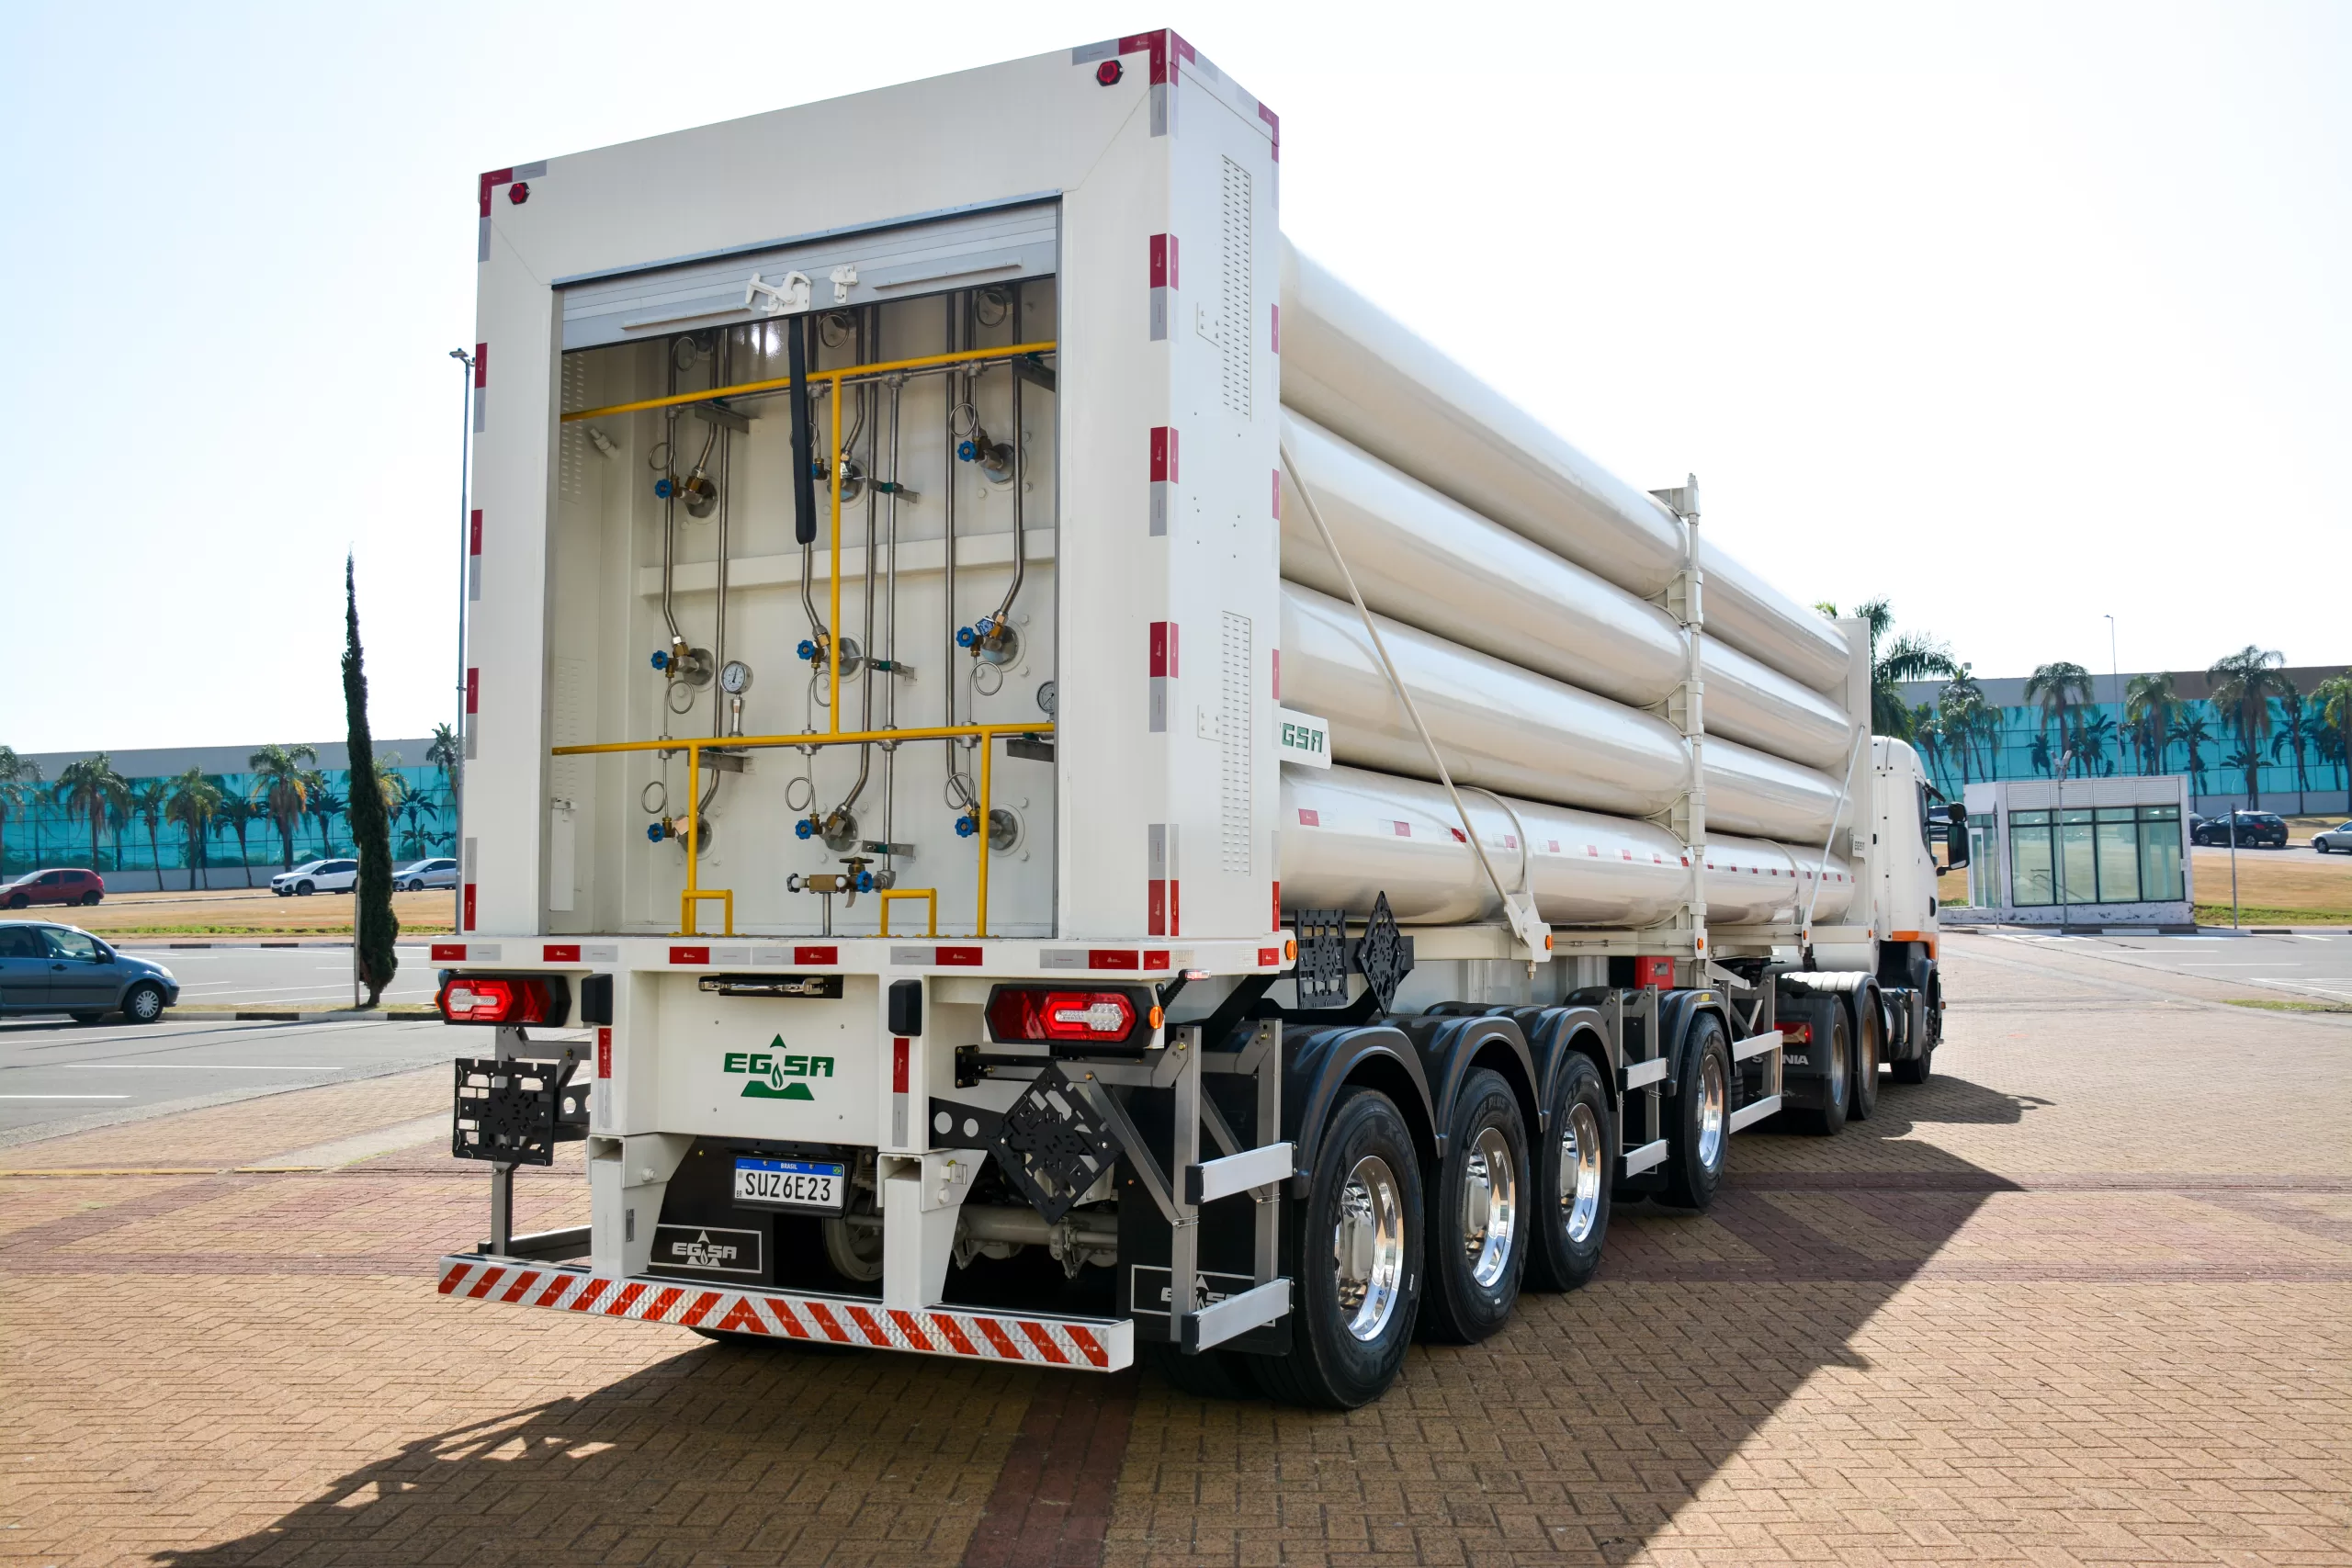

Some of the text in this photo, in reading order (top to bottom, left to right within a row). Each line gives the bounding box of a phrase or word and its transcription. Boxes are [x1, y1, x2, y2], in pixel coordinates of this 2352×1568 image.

[1280, 722, 1323, 753] GSA
[724, 1052, 834, 1077] EGSA
[1751, 1055, 1809, 1066] SNIA
[780, 1162, 797, 1170] BRASIL
[745, 1172, 831, 1201] SUZ6E23
[672, 1242, 737, 1259] EGSA
